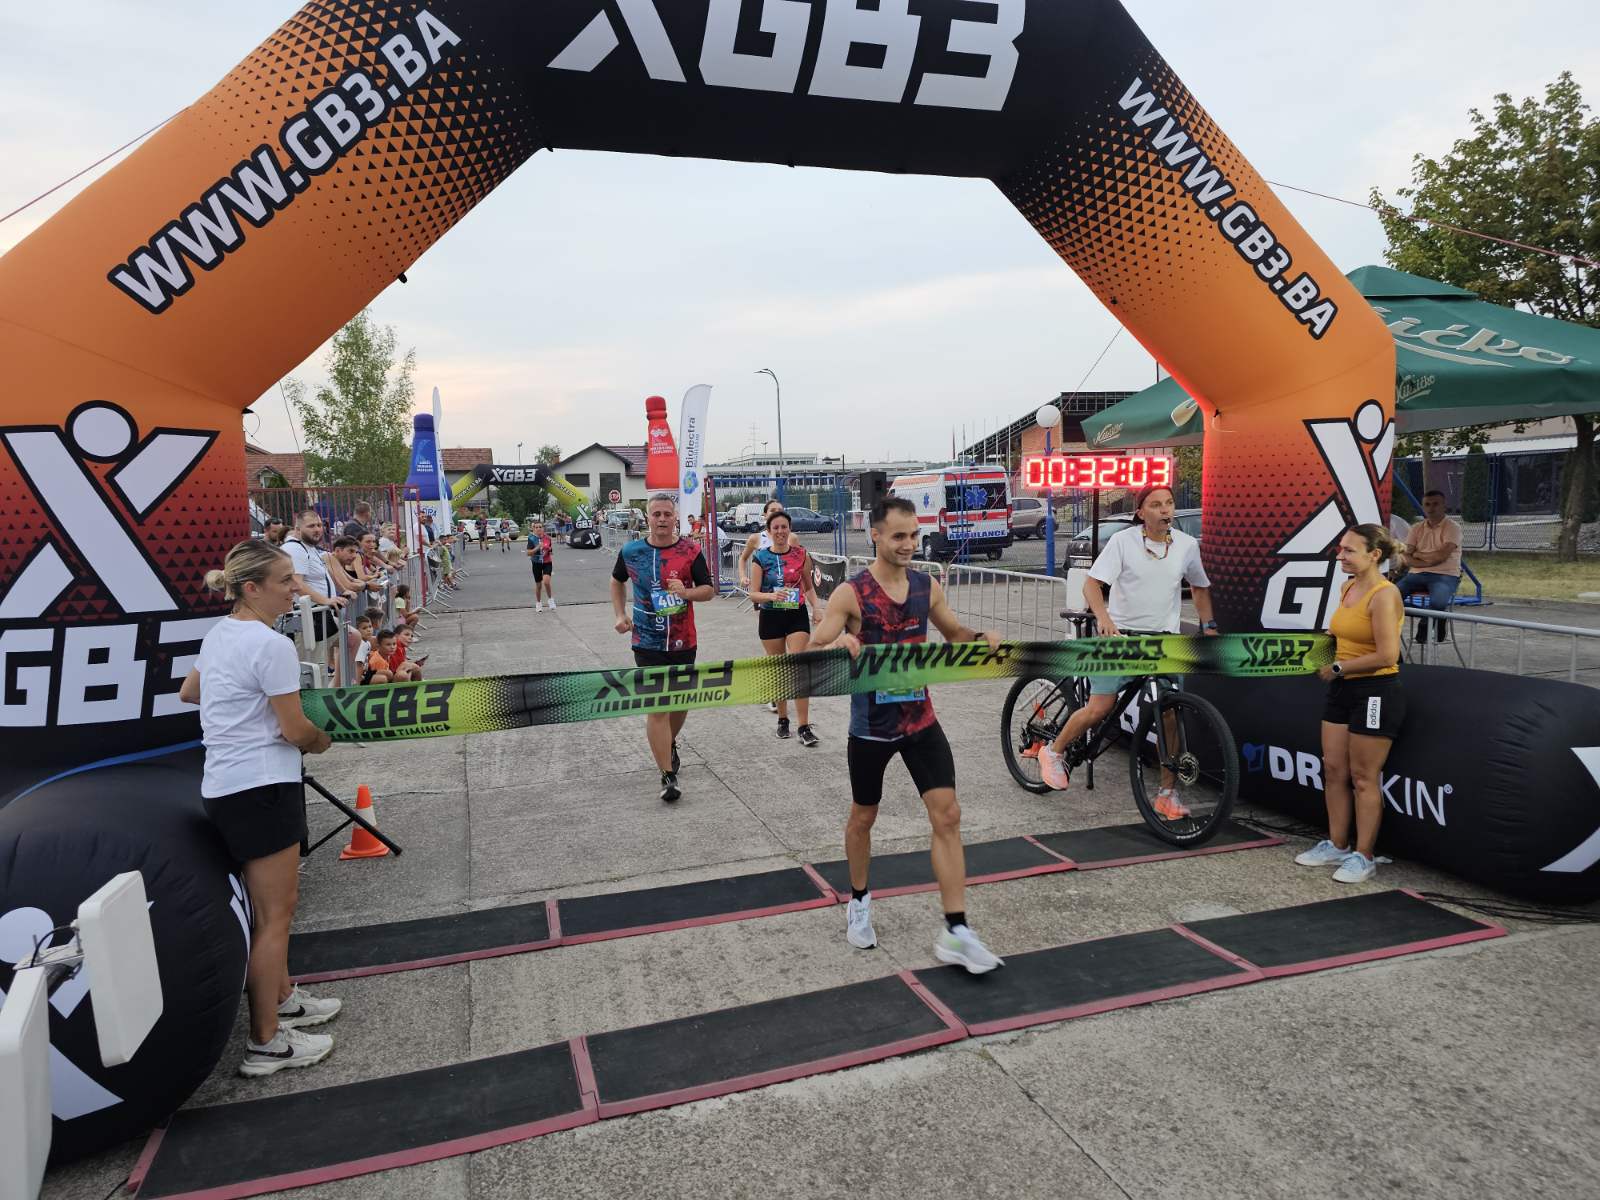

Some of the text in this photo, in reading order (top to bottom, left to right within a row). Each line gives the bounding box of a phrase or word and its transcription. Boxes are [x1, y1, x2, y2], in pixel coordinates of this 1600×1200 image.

[115, 9, 462, 309] WWW.GB3.BA
[1118, 77, 1336, 337] WWW.GB3.BA
[1025, 456, 1170, 487] 00:32:03
[850, 641, 1014, 680] WINNER
[673, 690, 722, 705] TIMING
[396, 724, 443, 736] TIMING
